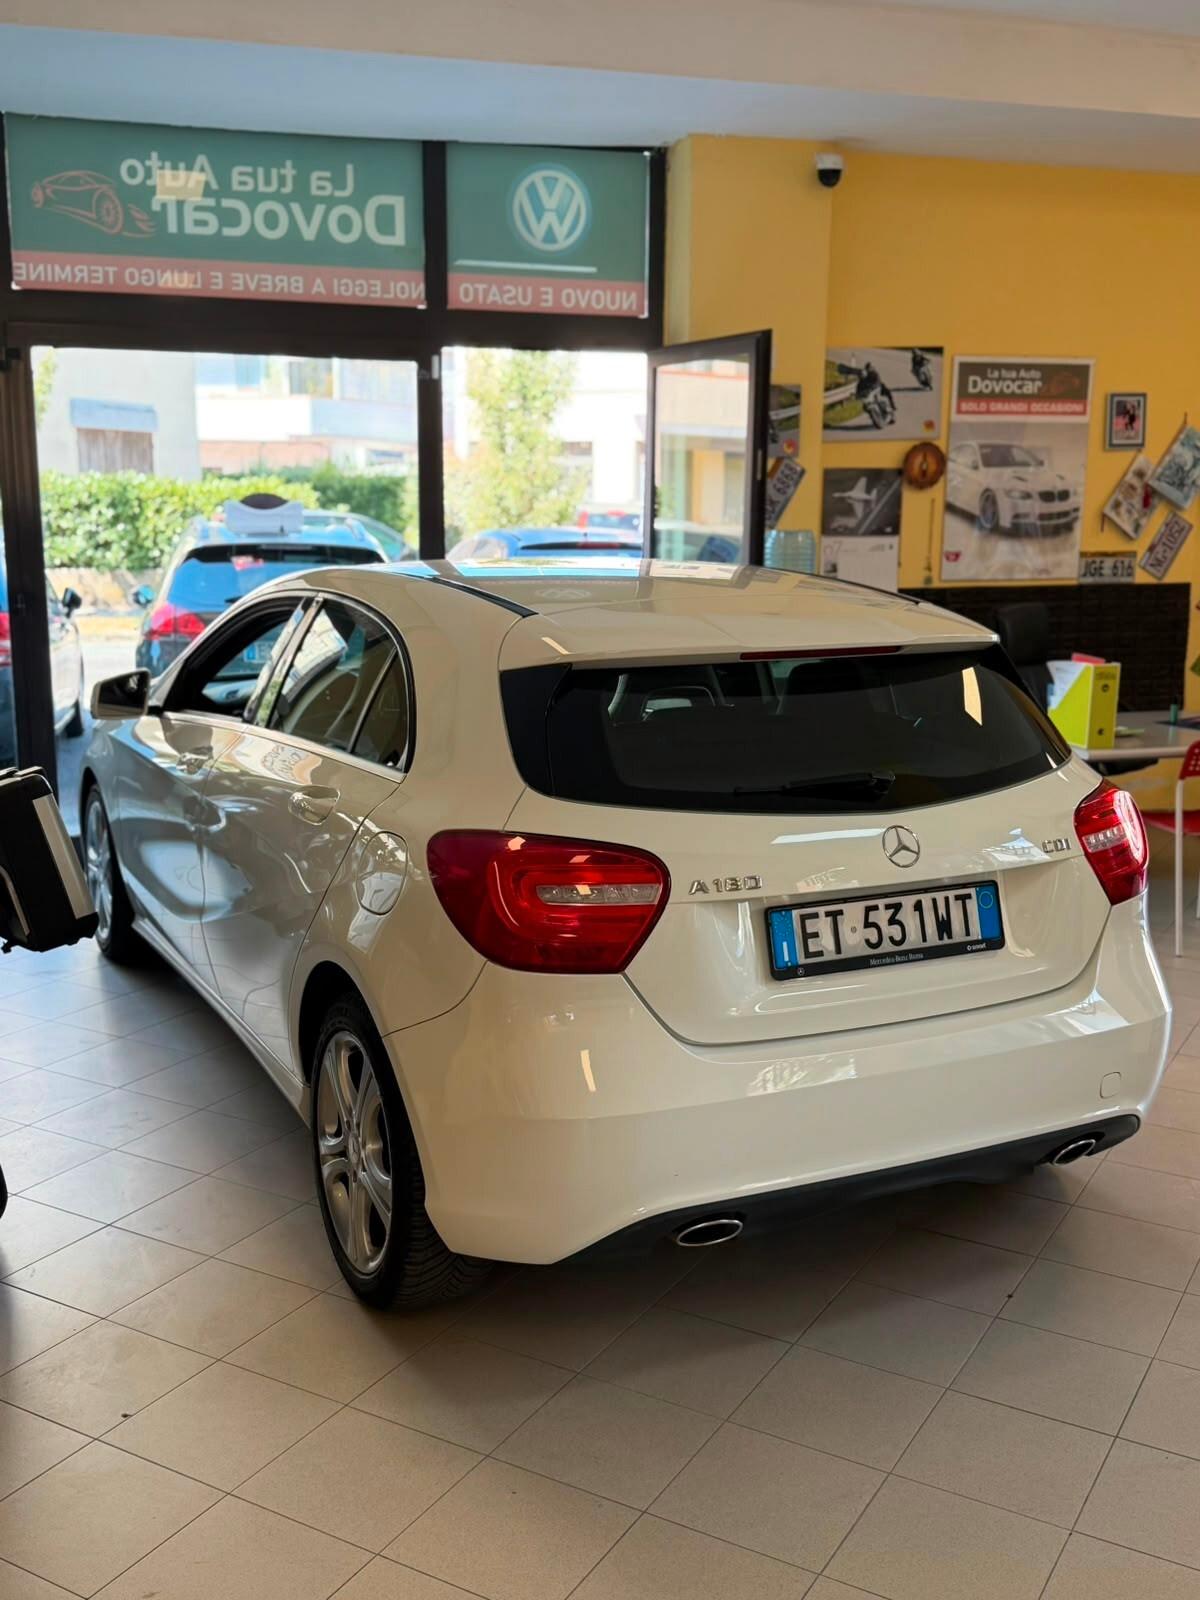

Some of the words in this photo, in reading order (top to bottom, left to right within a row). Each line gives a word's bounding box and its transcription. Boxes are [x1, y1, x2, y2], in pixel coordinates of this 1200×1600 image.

[987, 367, 999, 379] La
[1019, 368, 1042, 379] Auto
[967, 375, 1042, 394] Dovocar
[960, 402, 987, 412] SOLO
[989, 402, 1029, 412] GRANDI
[1030, 402, 1084, 413] OCCASIONI
[1041, 838, 1071, 854] CDI
[800, 908, 845, 959] ET
[862, 892, 974, 950] 531WT
